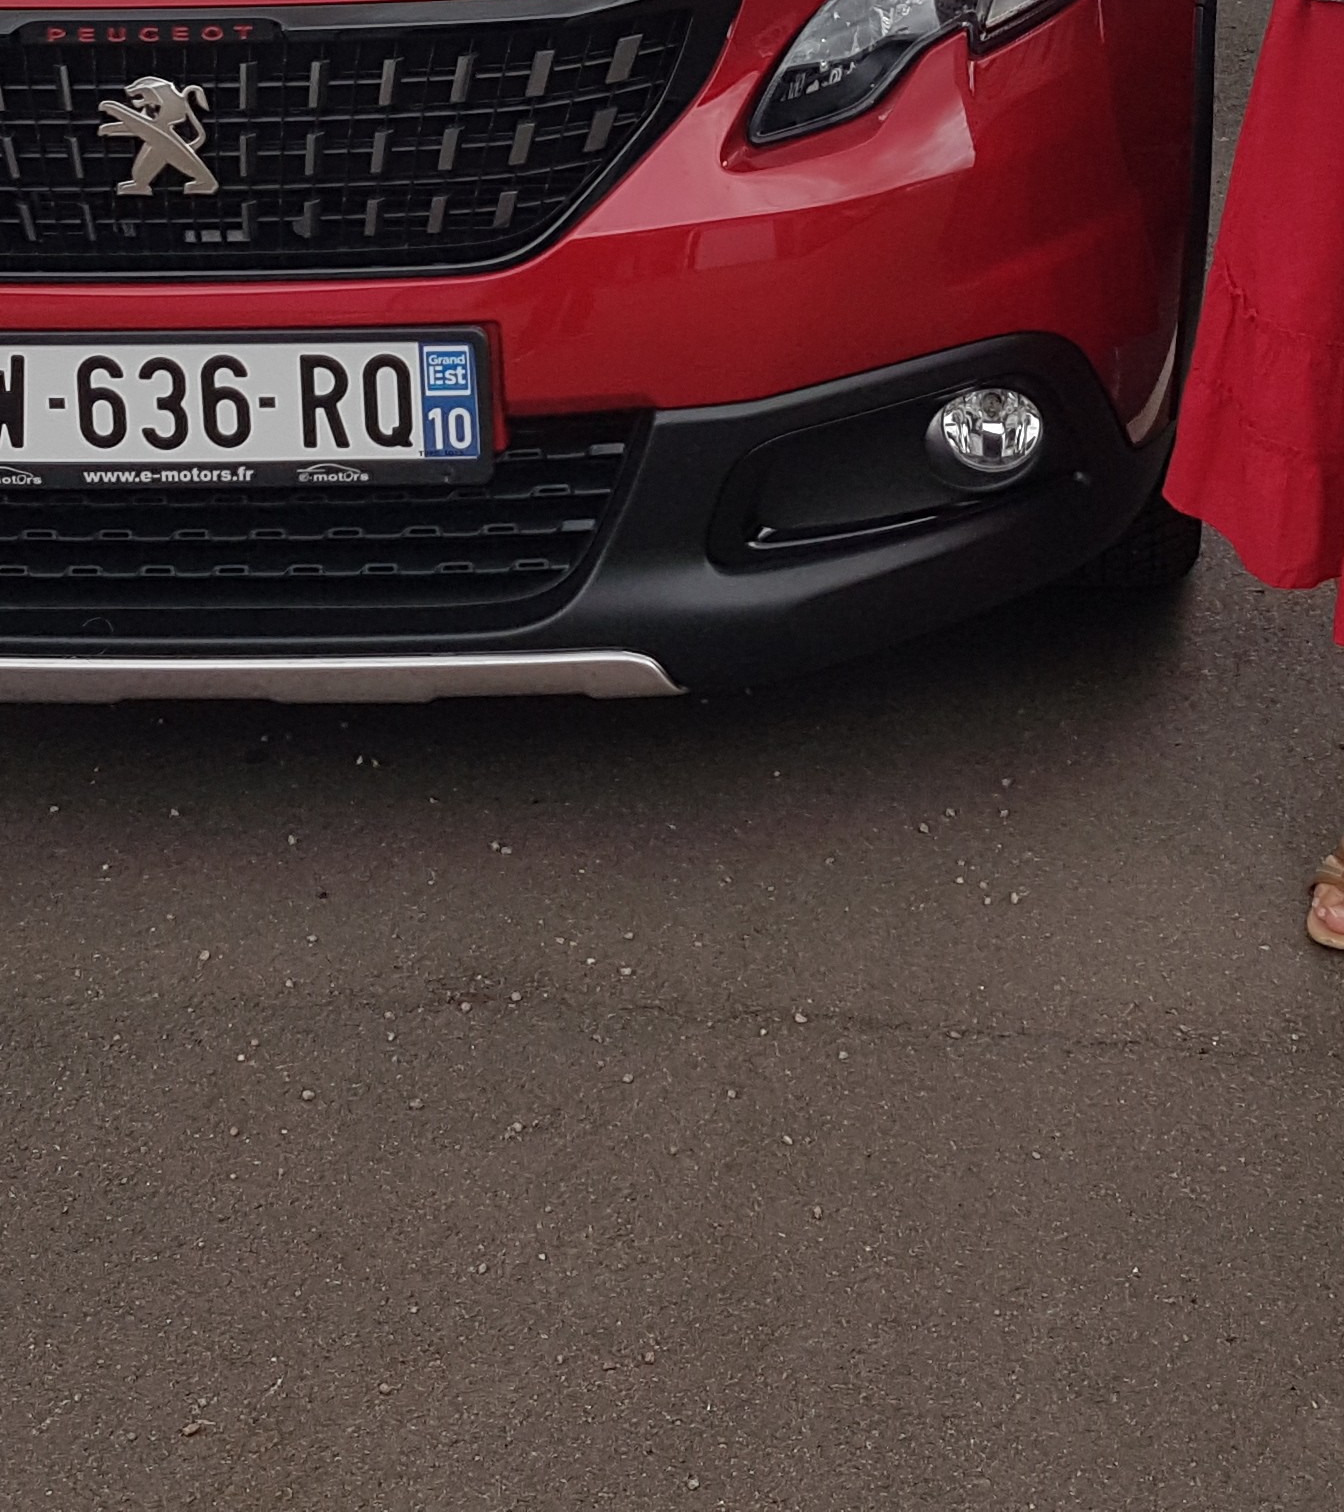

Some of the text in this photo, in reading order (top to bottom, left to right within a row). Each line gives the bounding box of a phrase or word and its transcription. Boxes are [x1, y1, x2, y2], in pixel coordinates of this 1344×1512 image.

[47, 25, 254, 43] PEUGEOT
[428, 354, 466, 365] Grand
[429, 365, 467, 386] Est
[427, 407, 472, 450] 10
[83, 467, 254, 483] www.e-motors.fr
